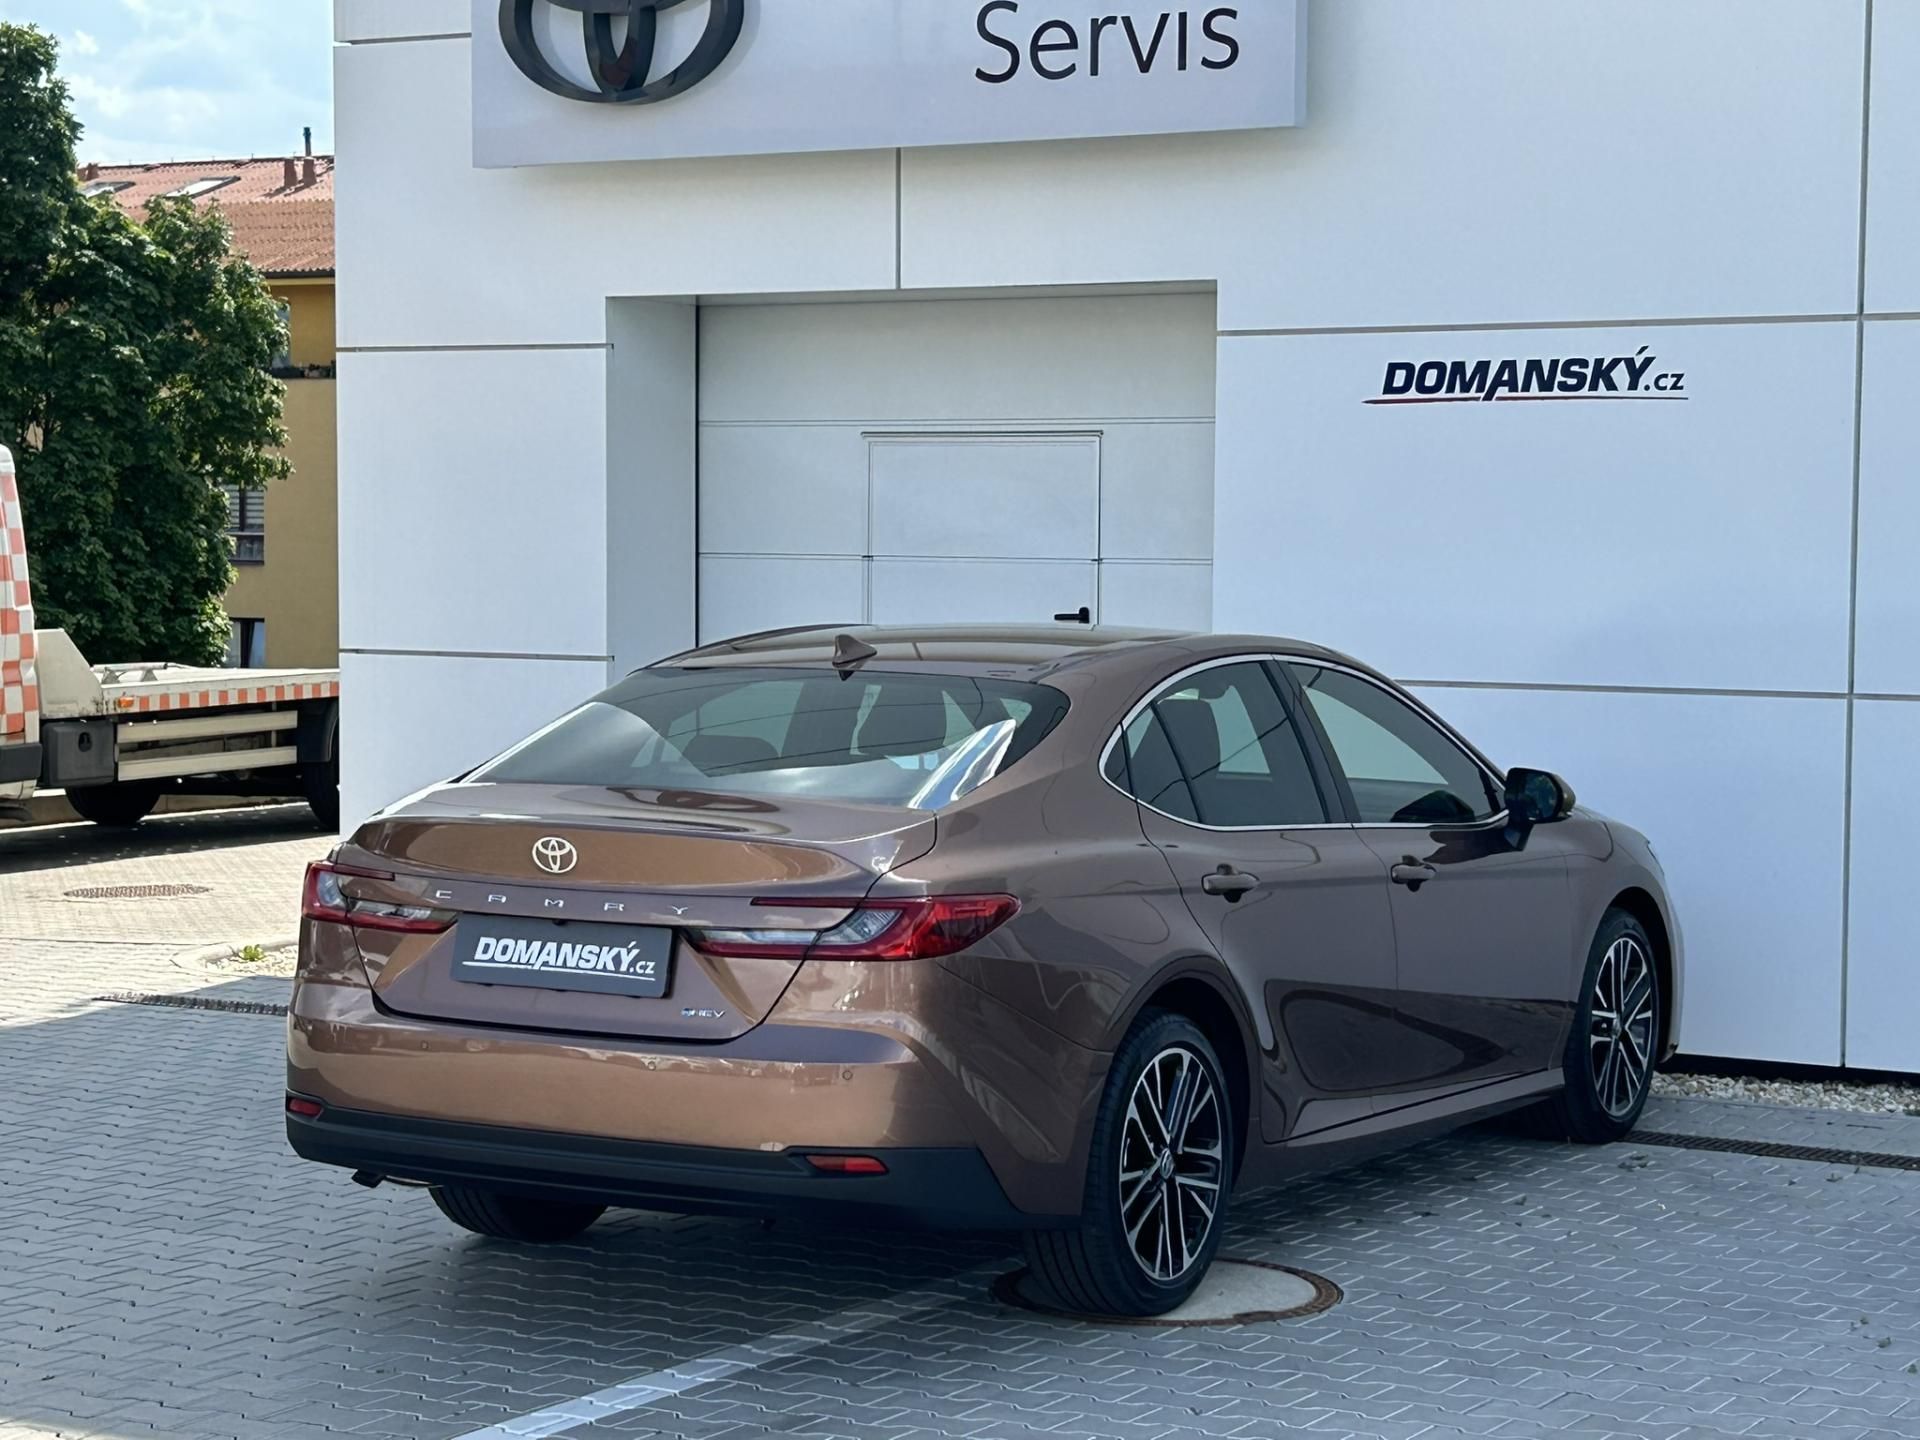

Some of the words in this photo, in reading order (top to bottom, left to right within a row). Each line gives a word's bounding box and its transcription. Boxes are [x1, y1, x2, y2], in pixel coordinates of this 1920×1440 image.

[975, 0, 1239, 84] Servis
[1382, 345, 1685, 402] DOMANSKÝ.cz
[435, 889, 690, 915] CAMRY
[473, 936, 656, 975] DOMANSKÝ.cz
